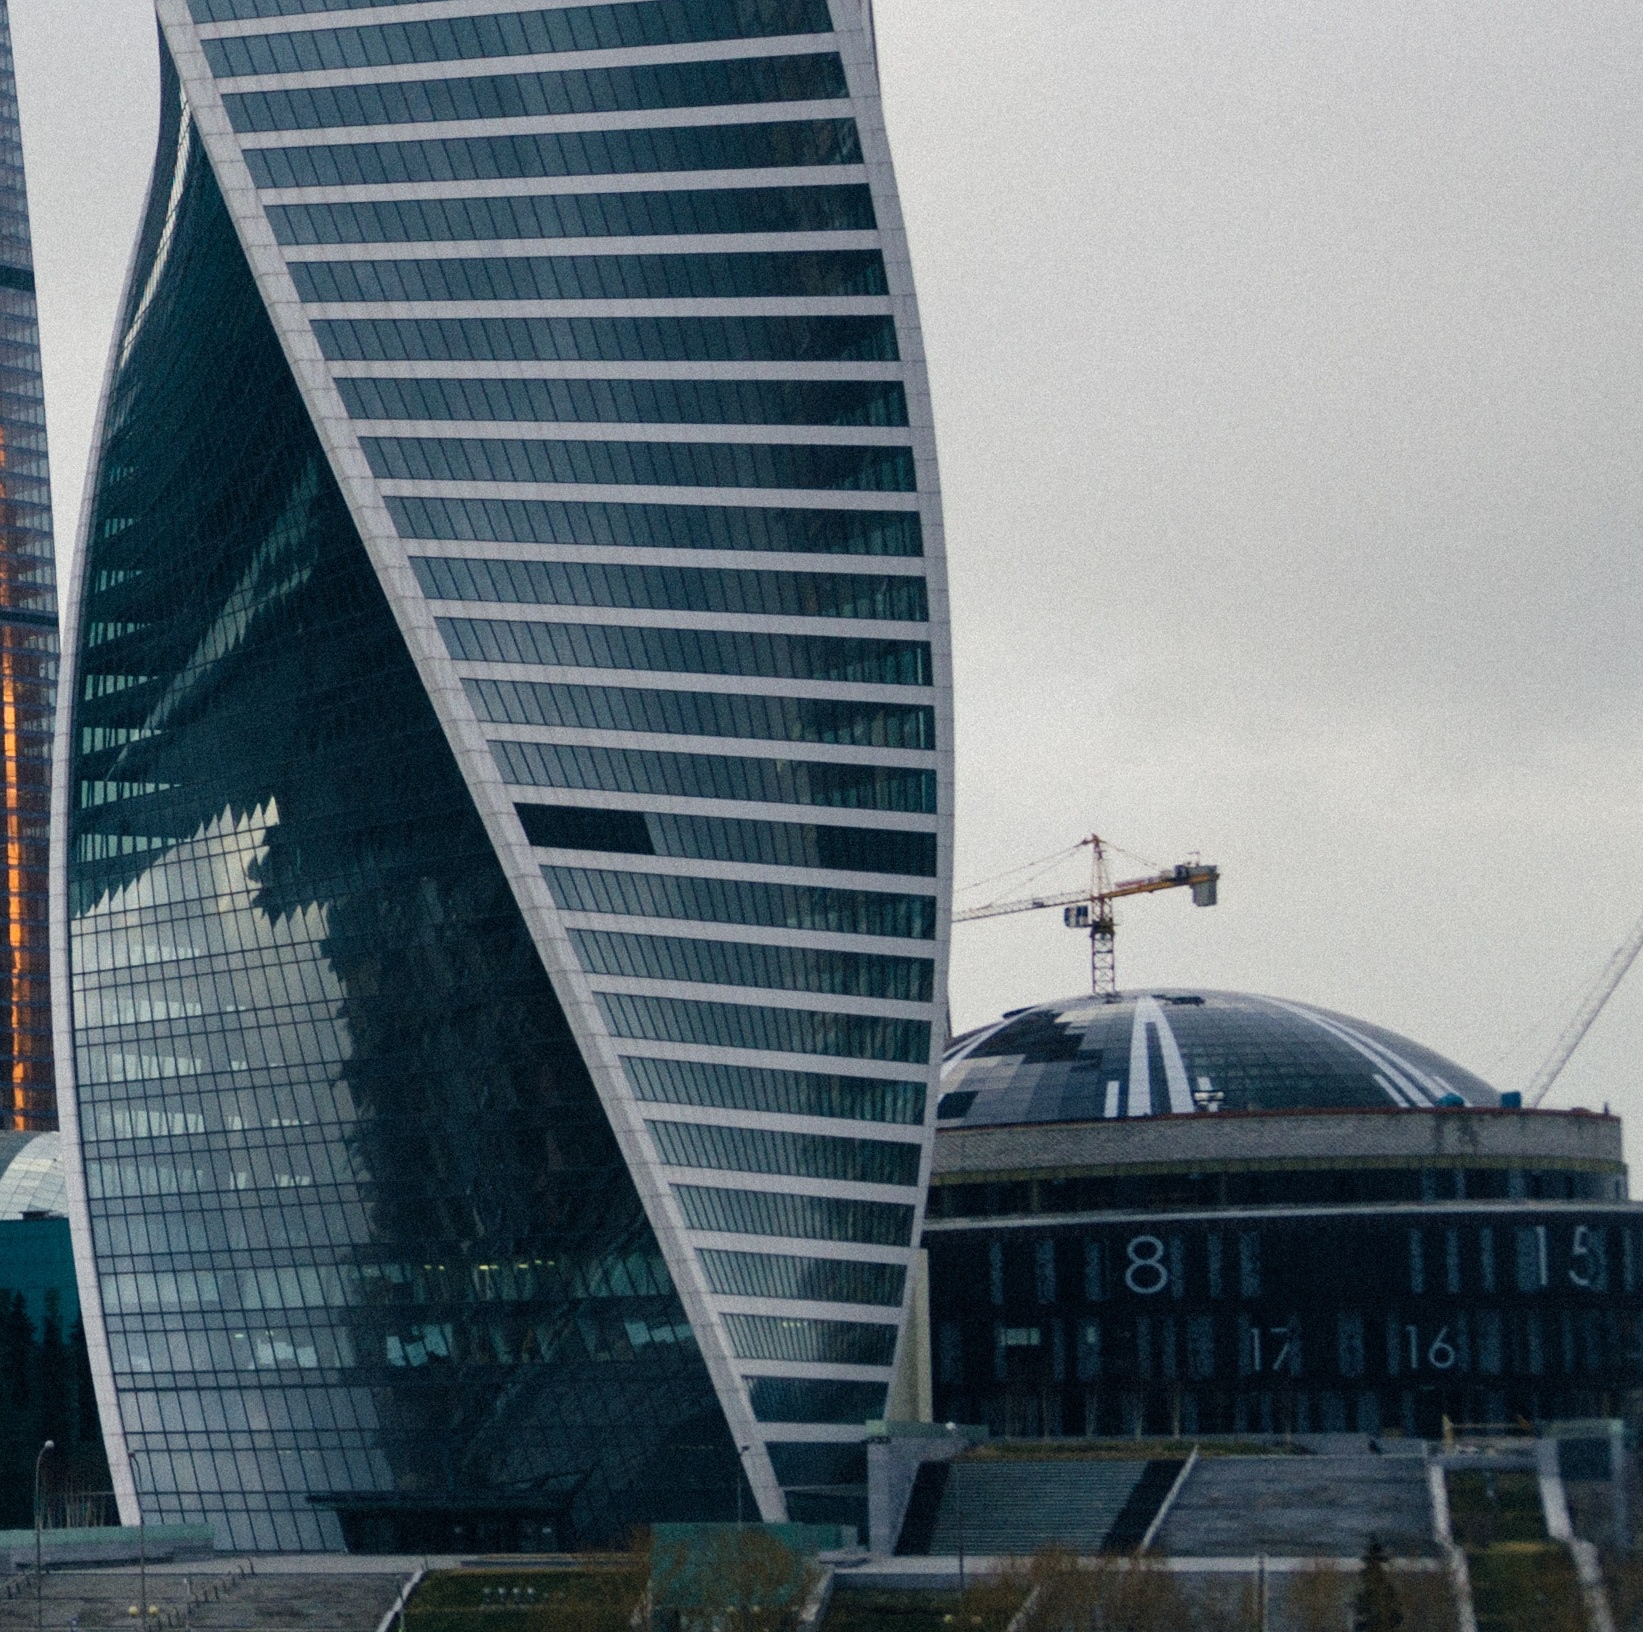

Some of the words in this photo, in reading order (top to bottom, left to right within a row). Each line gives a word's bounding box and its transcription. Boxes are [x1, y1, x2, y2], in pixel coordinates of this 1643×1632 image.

[1125, 1235, 1168, 1294] 8
[1250, 1327, 1292, 1370] 17
[1405, 1325, 1455, 1369] 16
